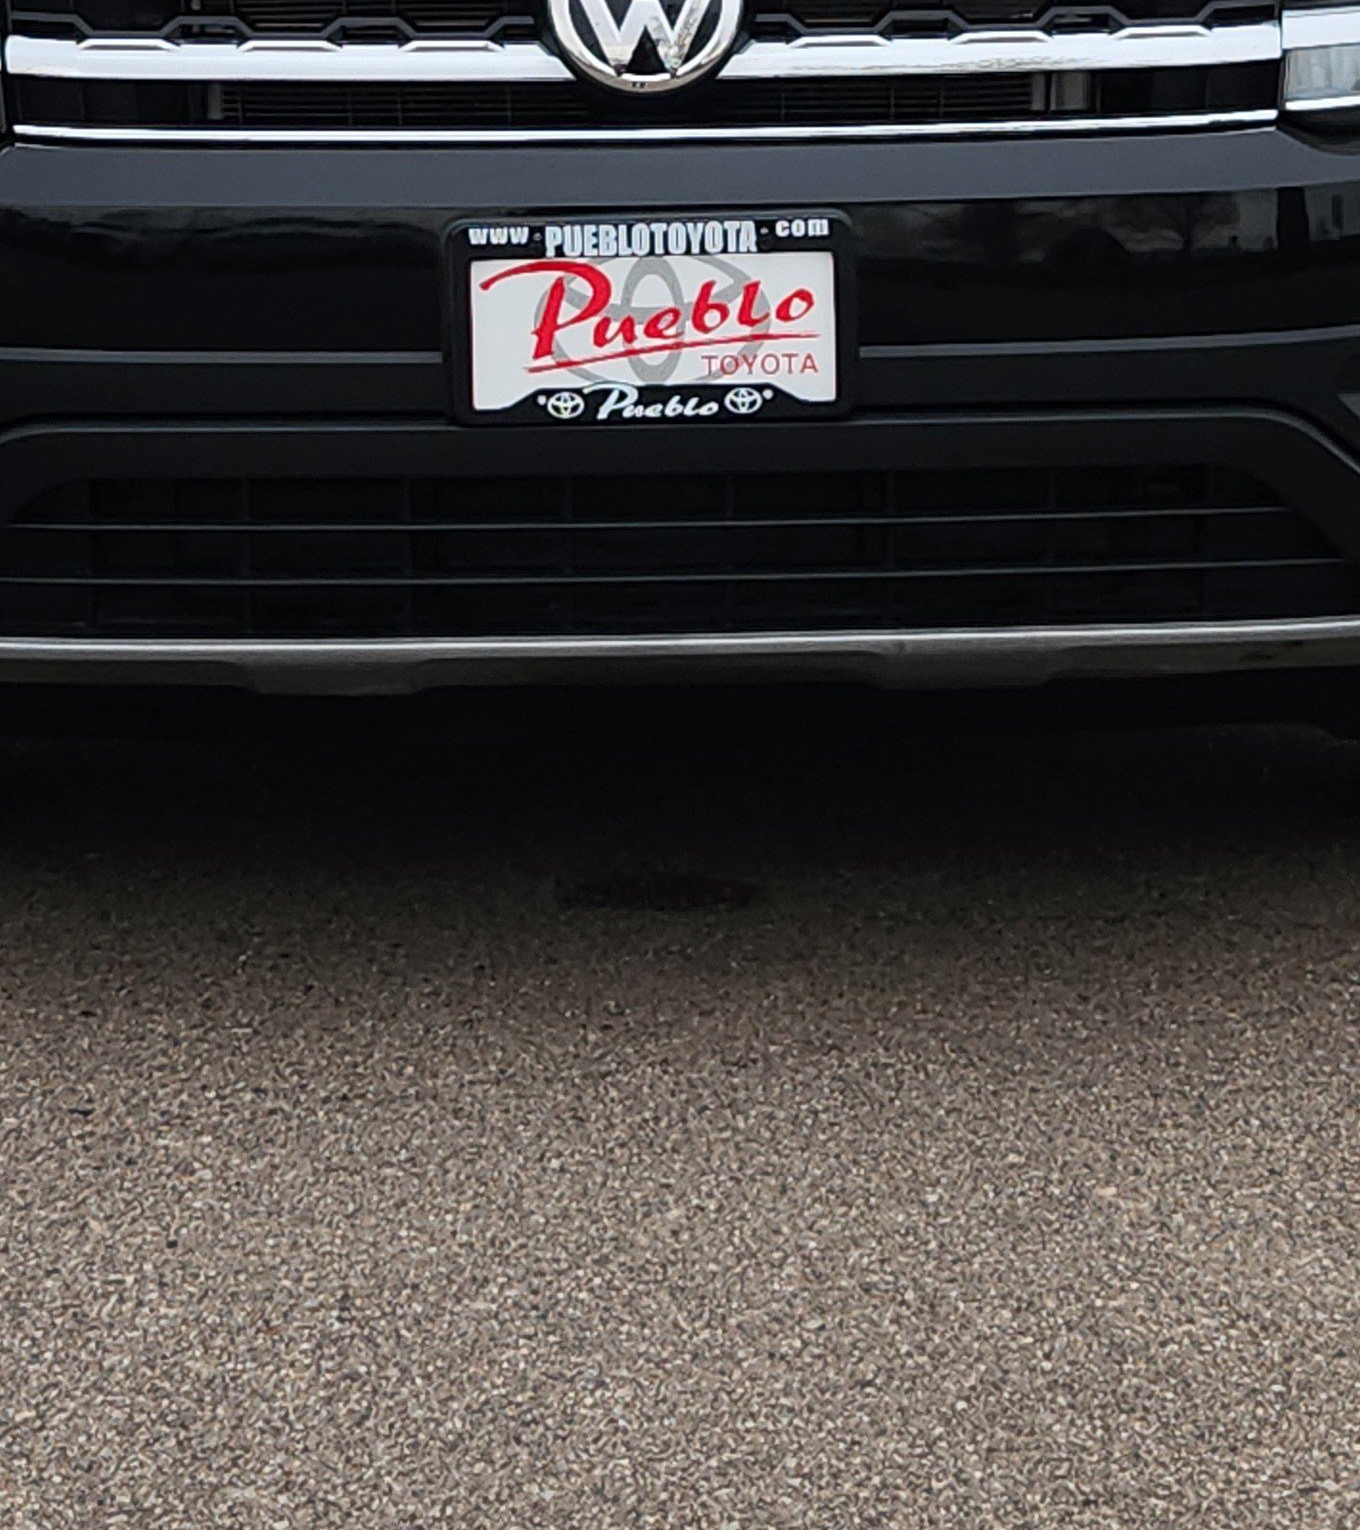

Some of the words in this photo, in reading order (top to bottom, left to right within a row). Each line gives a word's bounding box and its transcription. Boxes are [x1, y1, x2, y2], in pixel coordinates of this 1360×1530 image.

[468, 226, 529, 245] www
[545, 220, 758, 257] PUEBLOTOYOTA
[775, 218, 830, 237] com
[480, 260, 815, 360] Pueblo
[701, 352, 819, 376] TOYOTA
[582, 382, 719, 420] Pueblo
